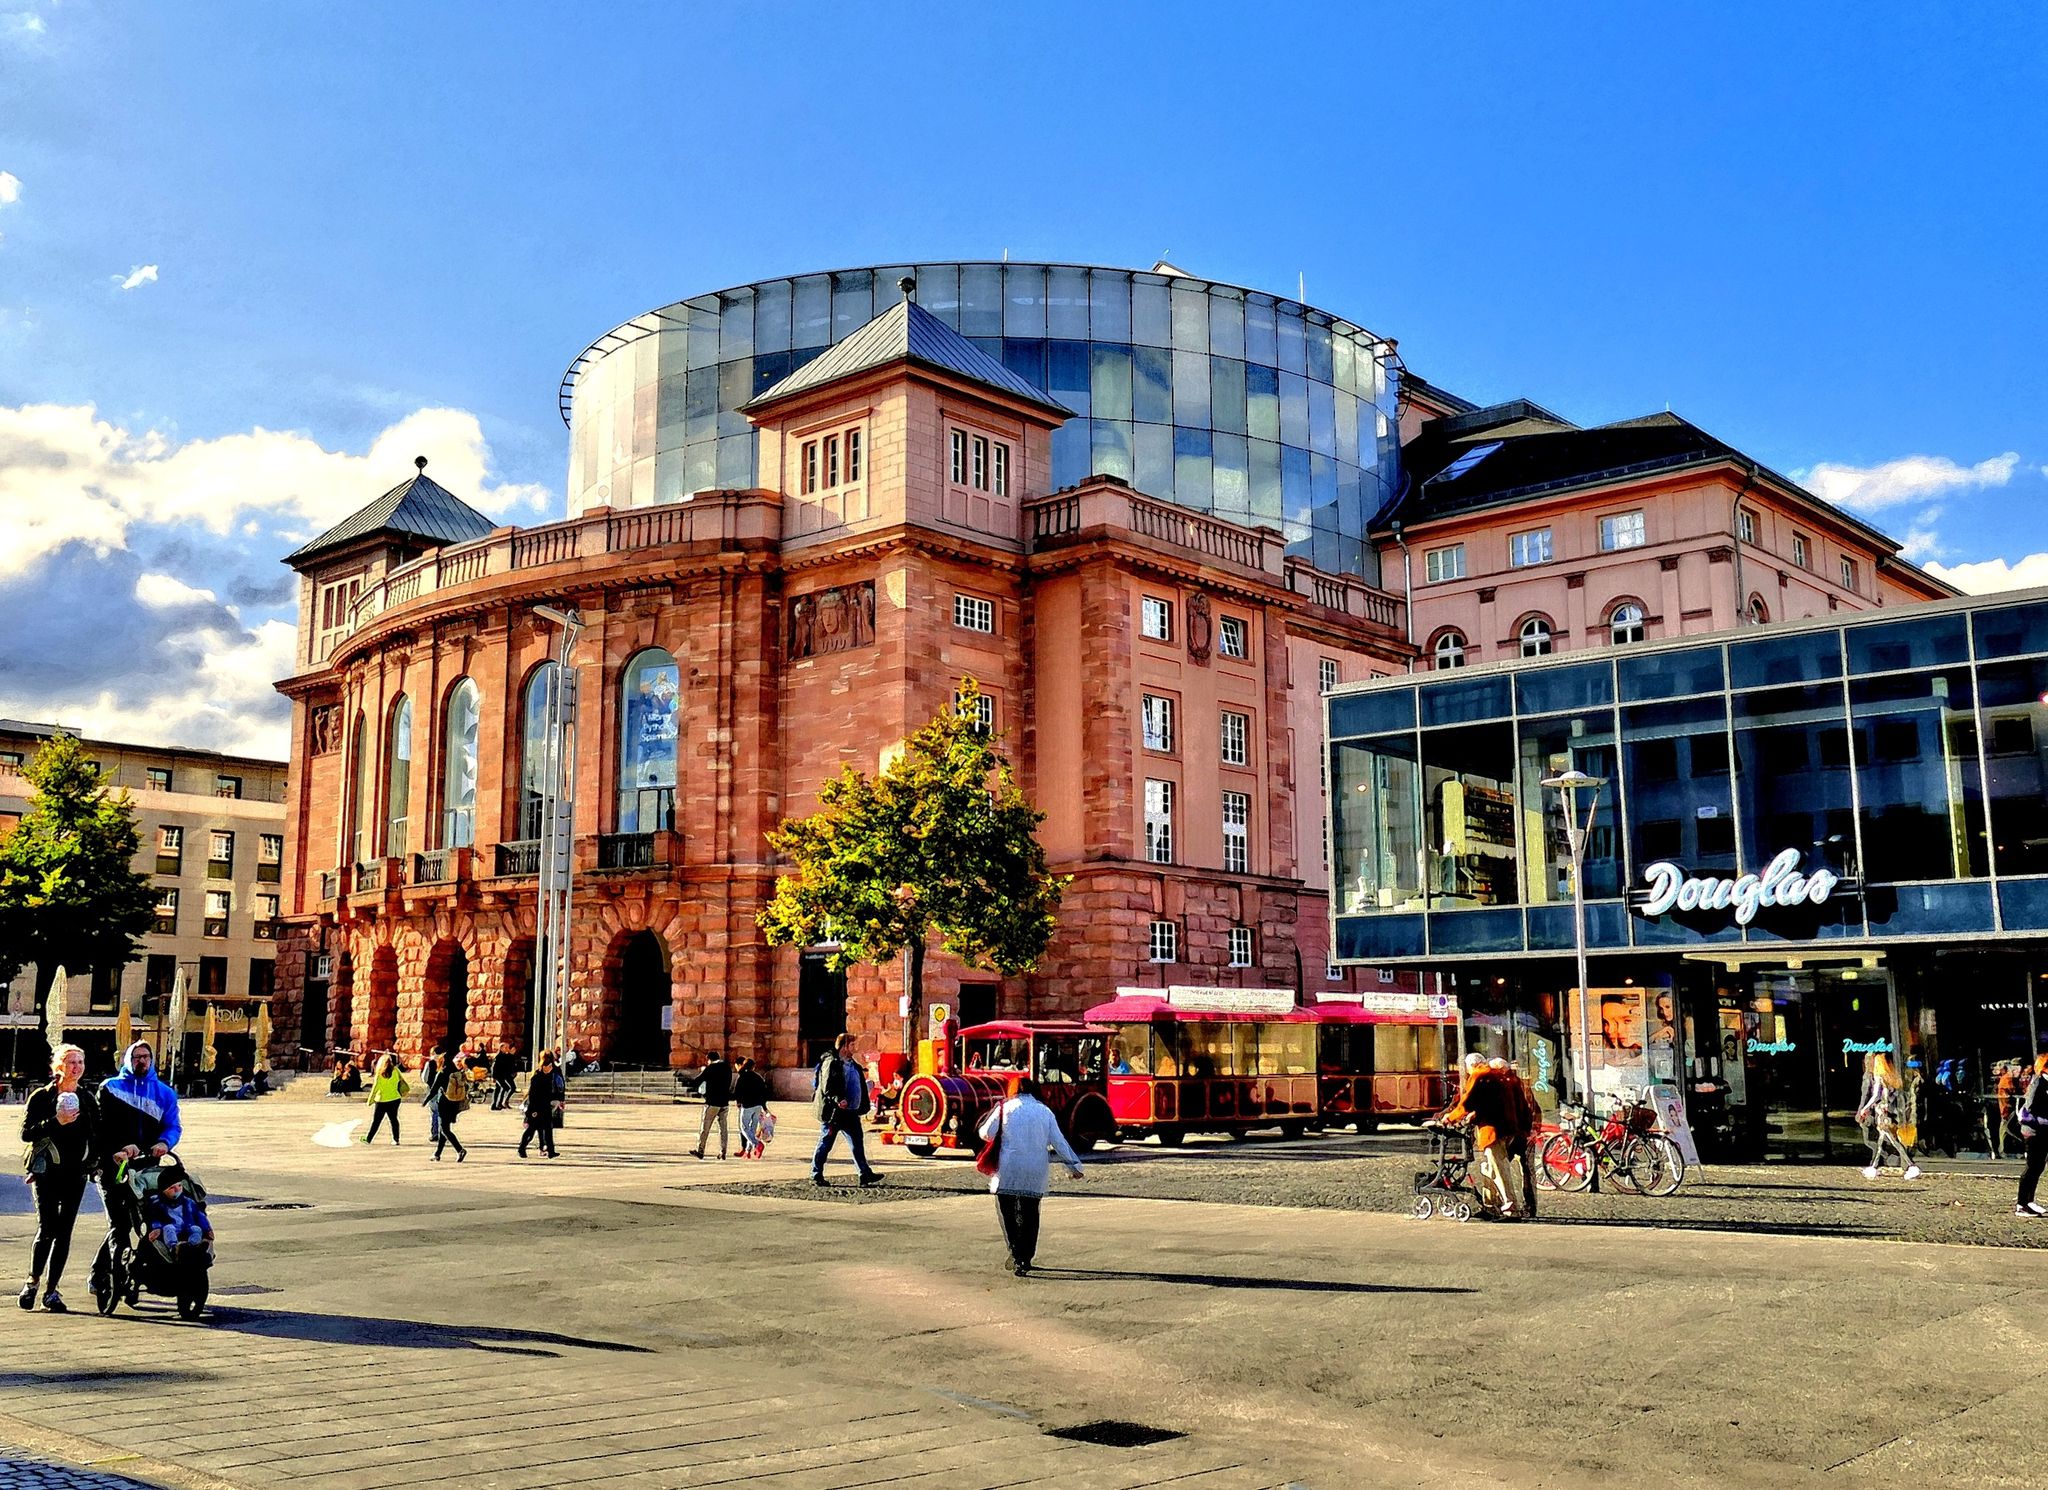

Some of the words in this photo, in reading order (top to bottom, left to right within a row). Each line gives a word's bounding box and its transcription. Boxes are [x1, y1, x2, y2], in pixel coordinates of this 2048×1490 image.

[1642, 847, 1838, 925] Douglas
[1747, 1038, 1796, 1056] Douglas
[1842, 1037, 1893, 1056] Douglas
[1532, 1039, 1550, 1092] Douglas
